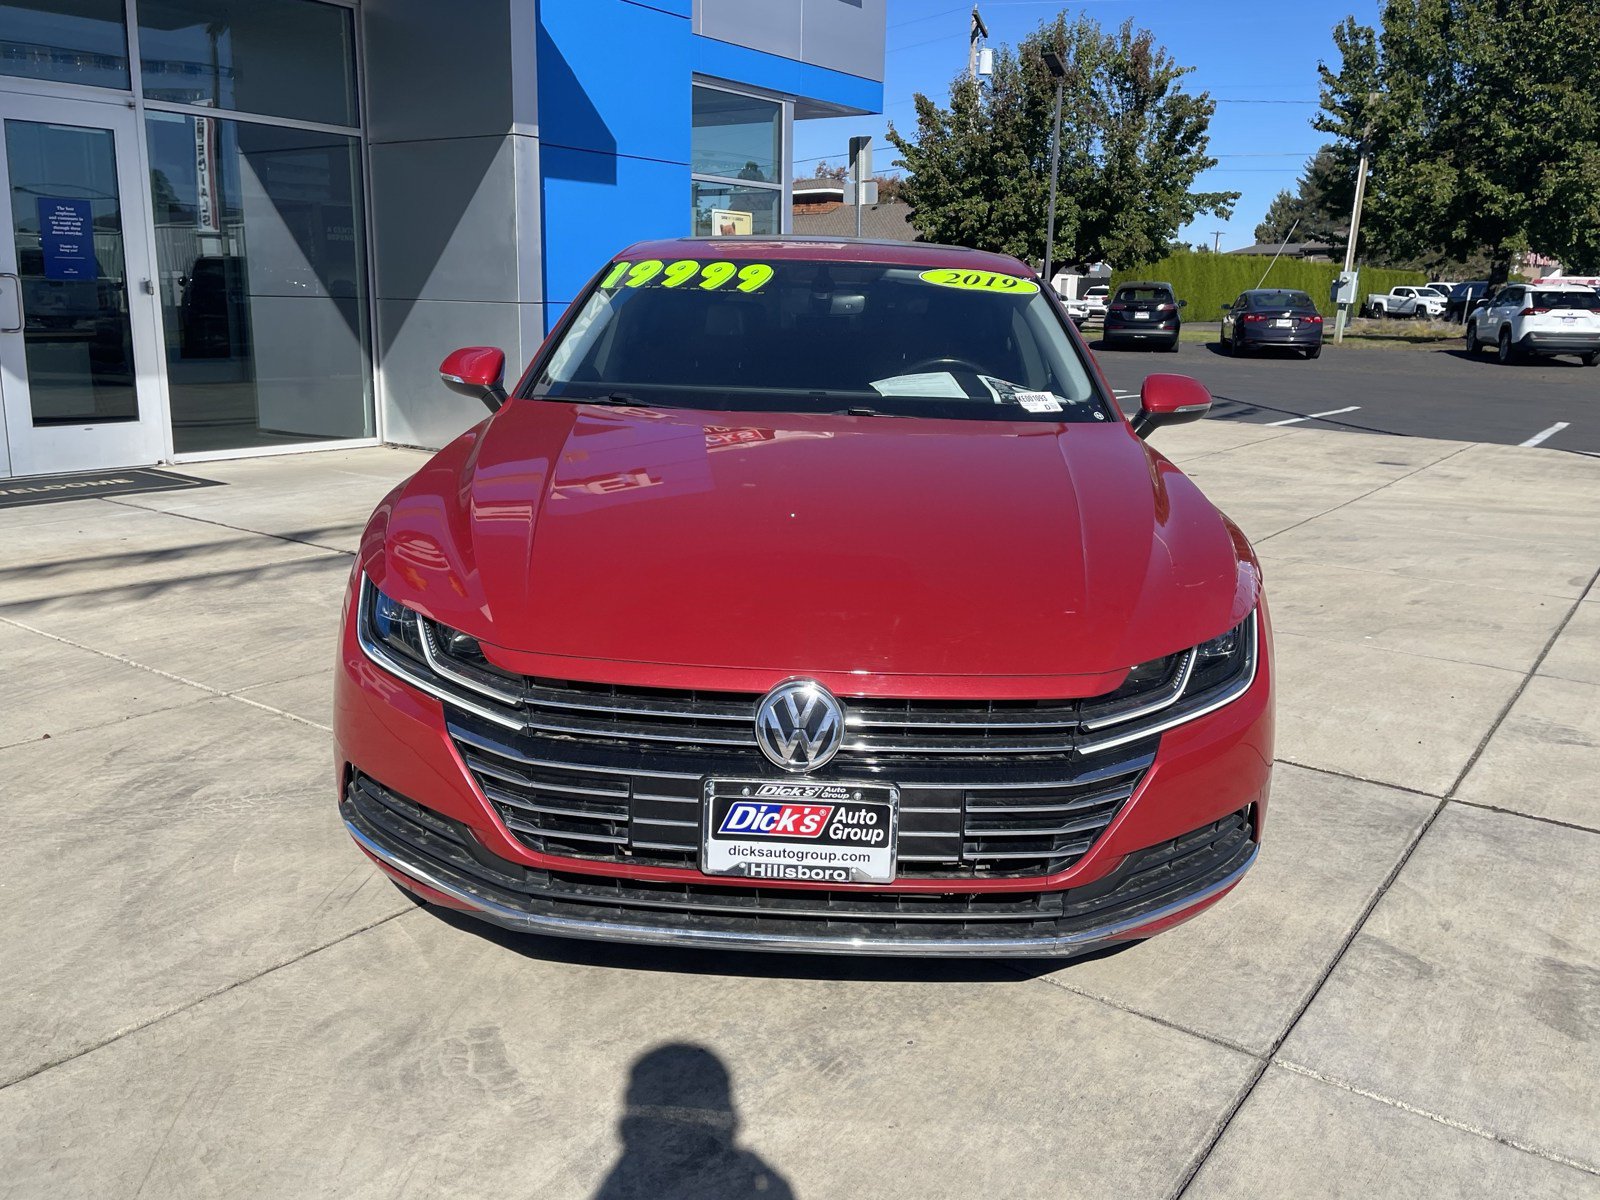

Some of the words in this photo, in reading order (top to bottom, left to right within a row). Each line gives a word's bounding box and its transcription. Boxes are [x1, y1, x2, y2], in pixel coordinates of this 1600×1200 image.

[600, 259, 775, 293] 19999
[943, 272, 1019, 289] 2019
[760, 785, 817, 797] Dick's
[726, 805, 821, 834] Dick's
[832, 806, 878, 825] Auto
[829, 823, 884, 844] Group
[728, 845, 871, 863] dicksautogroup.com
[750, 863, 847, 881] Hillsboro
